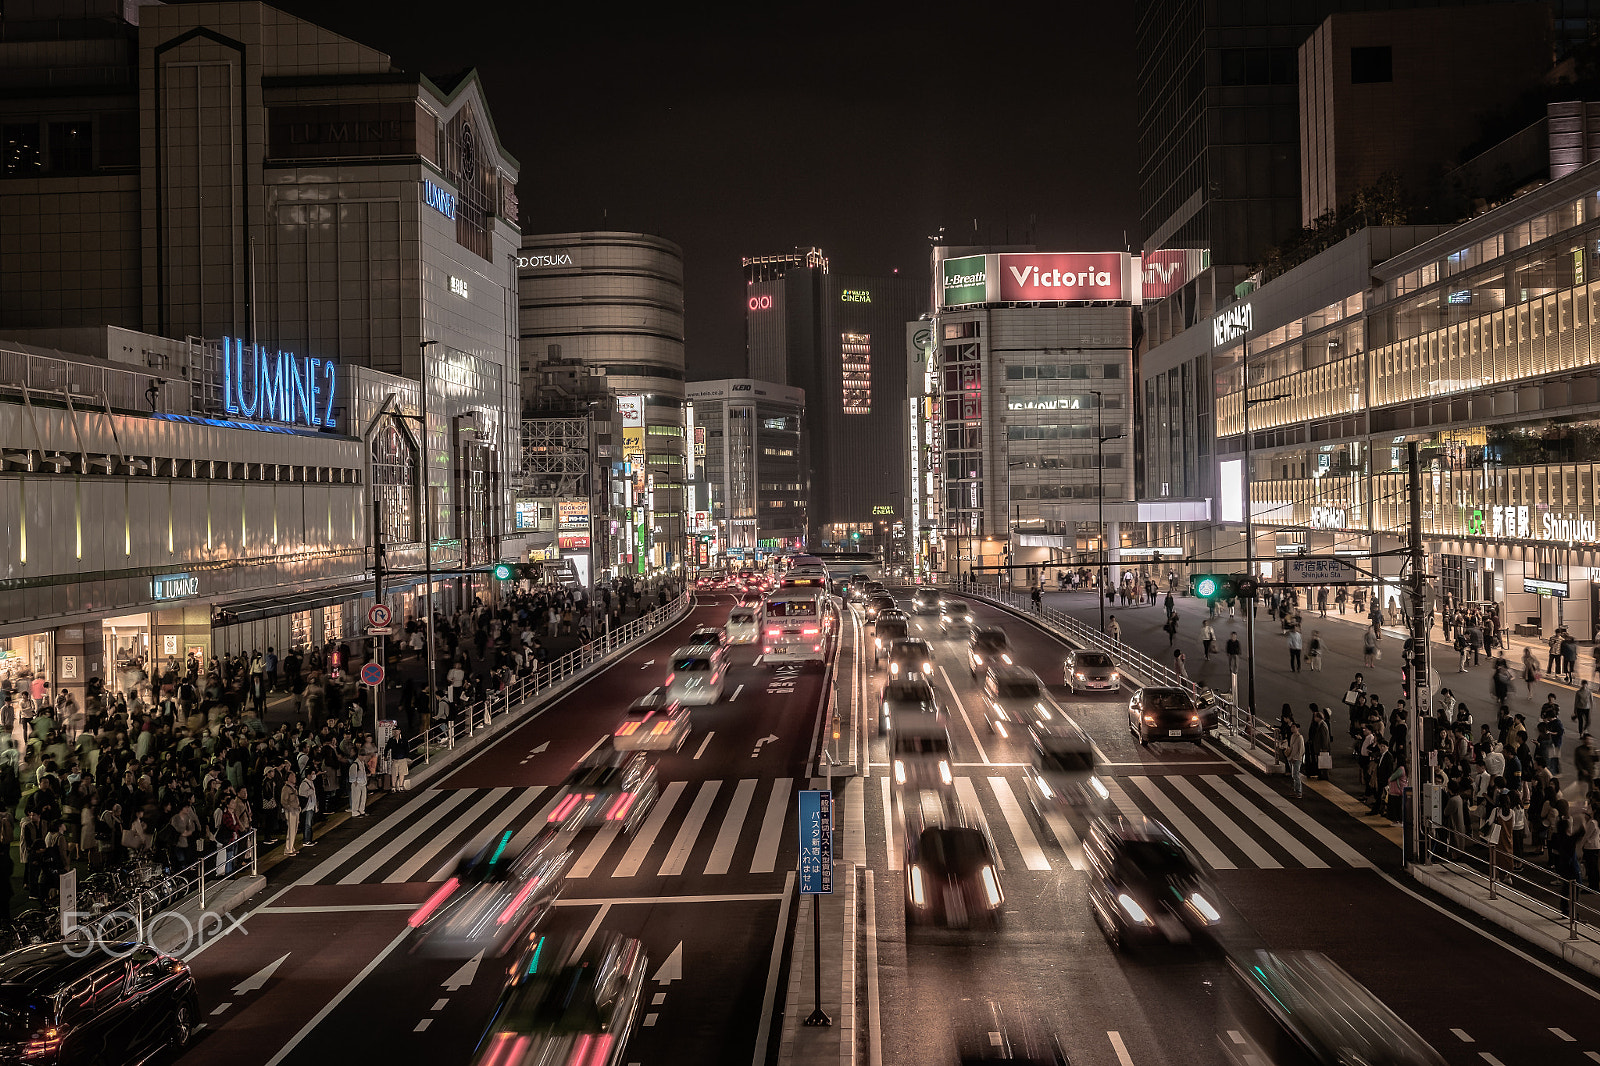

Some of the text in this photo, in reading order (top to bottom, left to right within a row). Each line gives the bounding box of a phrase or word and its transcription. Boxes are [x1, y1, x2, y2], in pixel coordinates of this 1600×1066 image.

[1009, 265, 1111, 288] Victoria
[1468, 509, 1483, 535] JR
[1542, 512, 1596, 548] Shinjuku
[1293, 560, 1351, 572] 新宿駅南口
[1301, 571, 1343, 579] Shinjuku Sta.
[811, 811, 821, 873] バスタ新宿へは
[802, 847, 812, 891] 入れません
